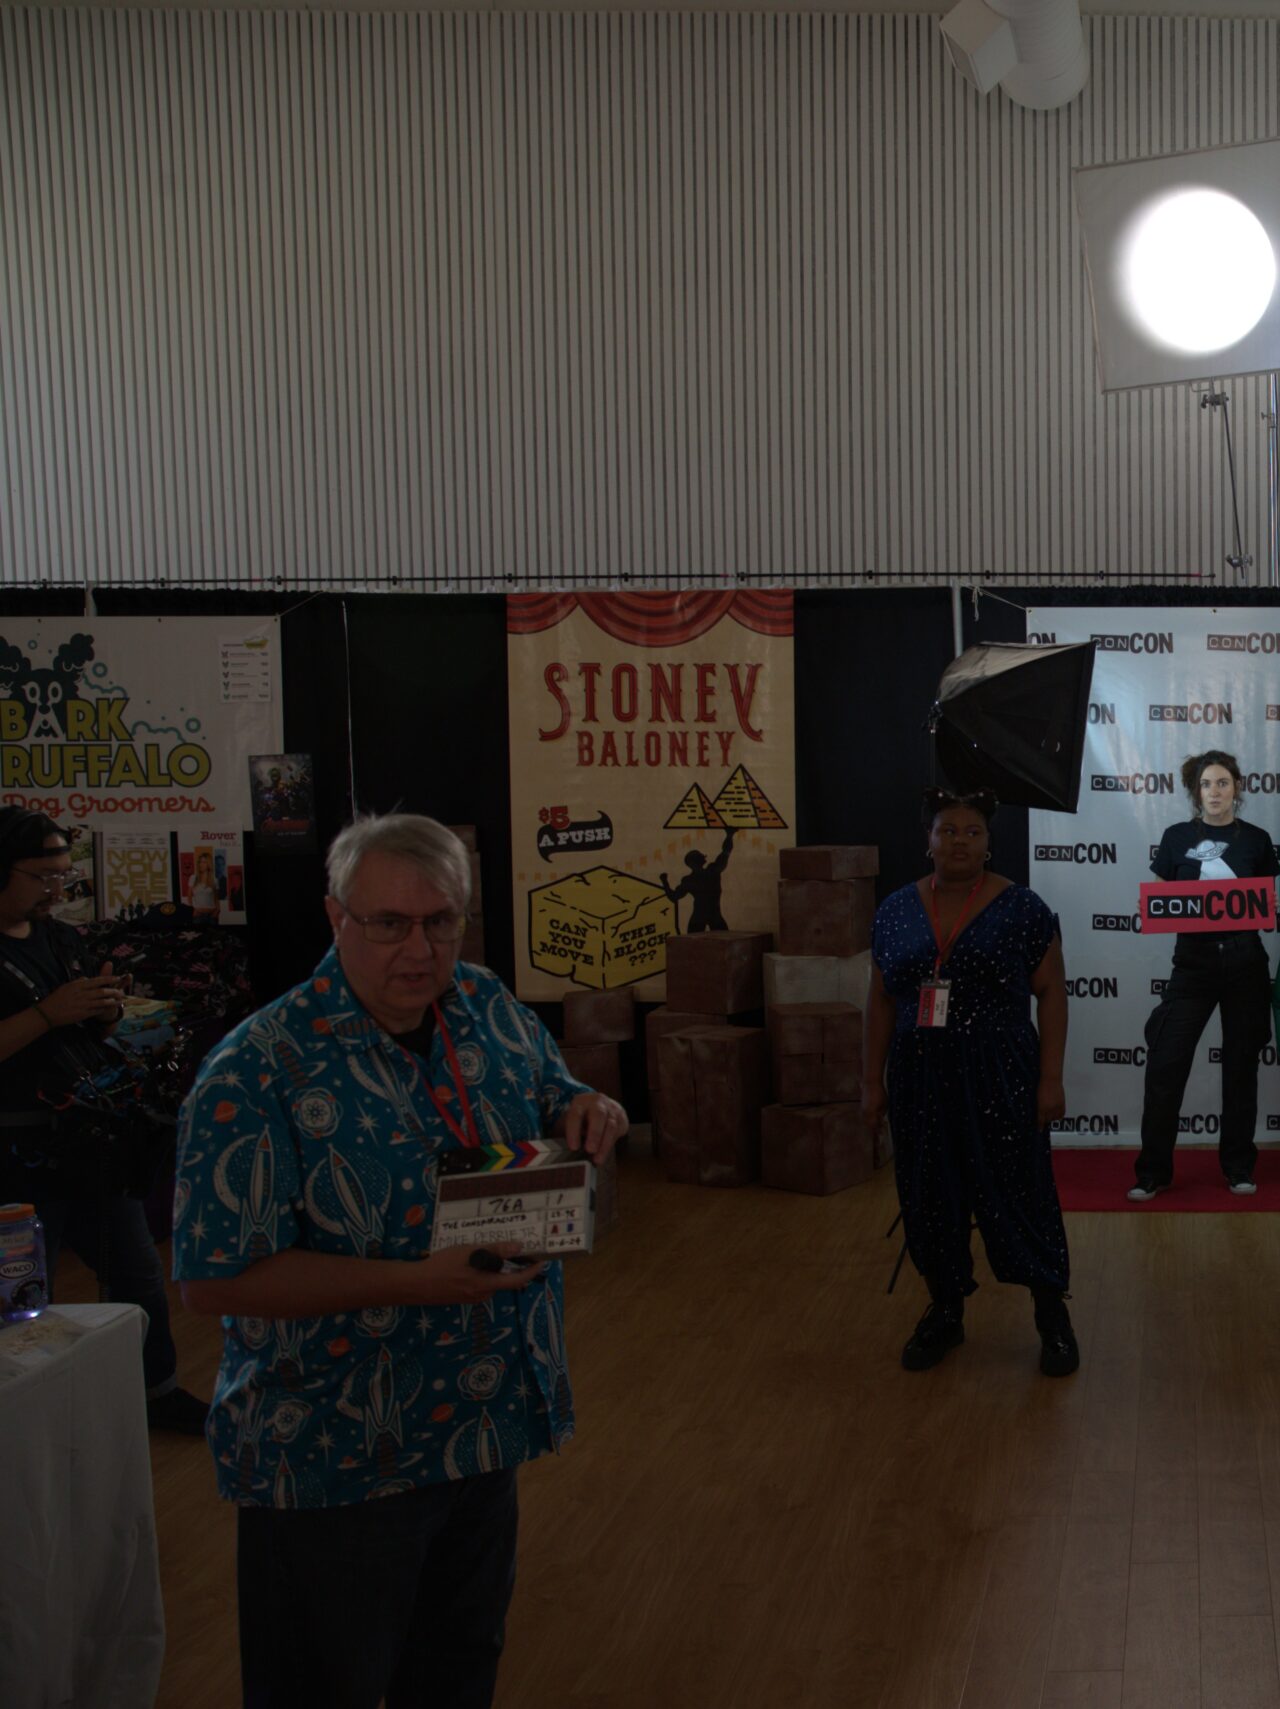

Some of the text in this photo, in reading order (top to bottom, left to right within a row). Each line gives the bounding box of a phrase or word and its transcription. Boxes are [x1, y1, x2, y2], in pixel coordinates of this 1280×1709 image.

[0, 697, 135, 741] BARK
[1149, 703, 1232, 724] CONCON
[576, 730, 736, 767] BALONEY
[0, 743, 211, 788] RUFFALO
[1091, 773, 1174, 794] CONCON
[3, 793, 215, 818] Dog Groomers
[538, 805, 570, 830] $5
[201, 831, 237, 840] Rover
[539, 827, 612, 848] A PUSH
[107, 850, 168, 863] NOW
[1034, 843, 1117, 864] CONCON
[110, 862, 168, 875] YOU
[107, 875, 168, 890] PEE
[1147, 887, 1270, 921] CONCON
[550, 918, 588, 937] CAN
[619, 923, 656, 943] THE
[549, 931, 586, 949] YOU
[540, 941, 594, 966] MOVE
[629, 950, 657, 966] ???
[1093, 1046, 1145, 1067] CONC
[489, 1198, 523, 1214] 76A
